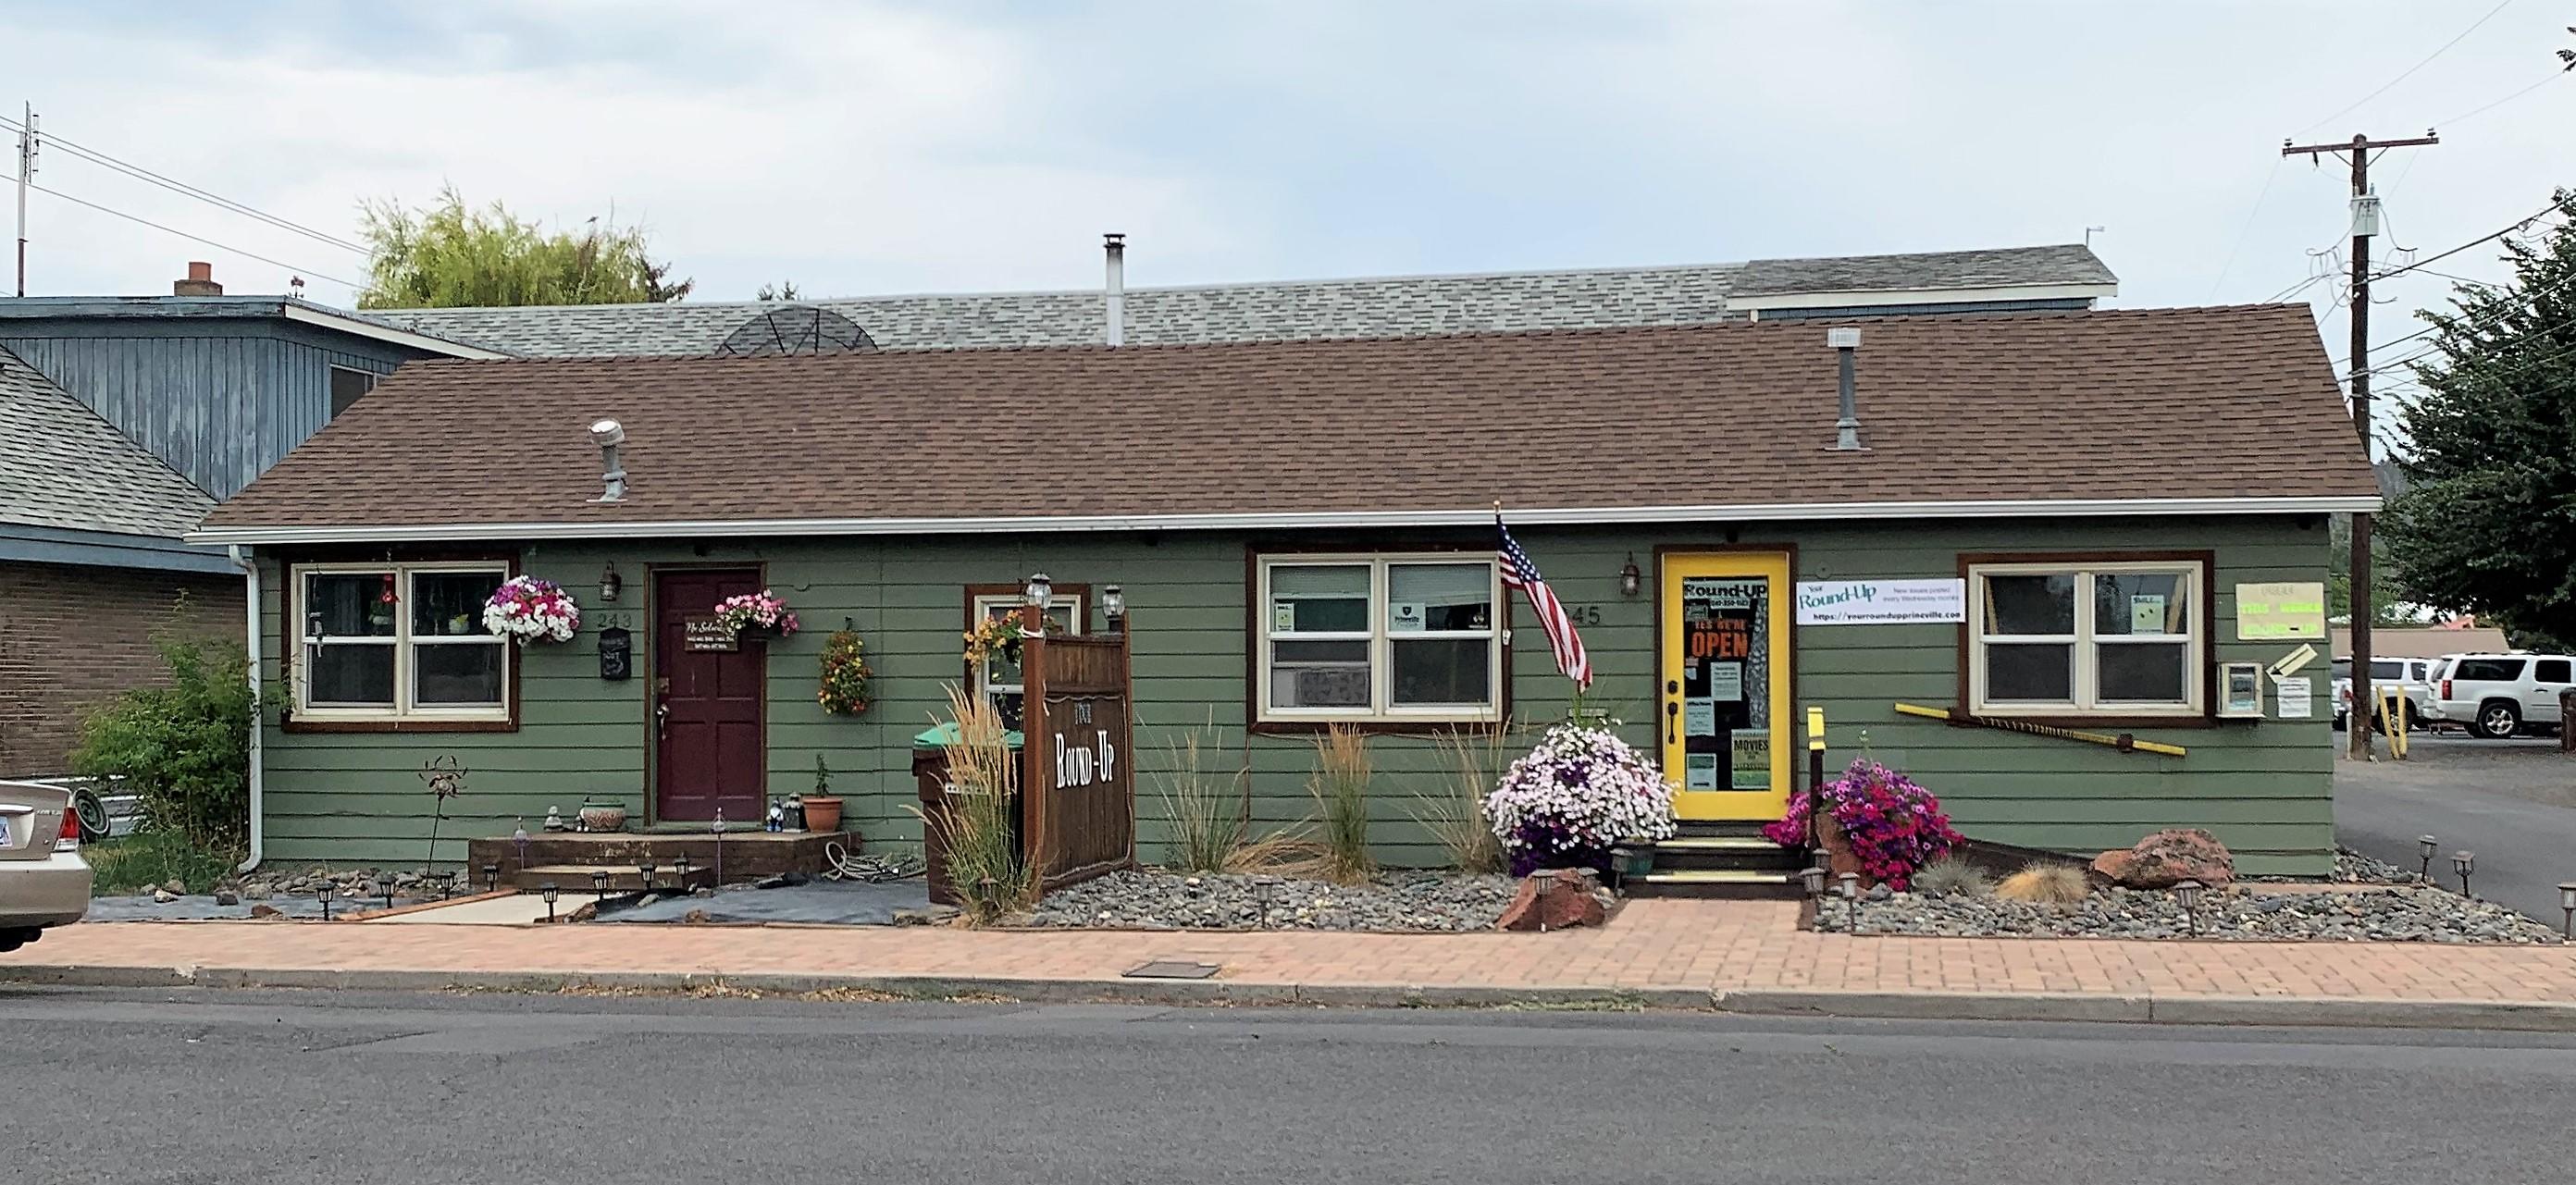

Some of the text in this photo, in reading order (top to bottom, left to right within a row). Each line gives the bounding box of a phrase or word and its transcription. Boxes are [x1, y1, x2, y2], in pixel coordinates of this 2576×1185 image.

[1800, 584, 1877, 610] Round-Up
[1808, 585, 1823, 594] Your
[598, 613, 631, 628] 243
[1691, 631, 1748, 658] OPEN
[1733, 739, 1769, 751] MOVIES
